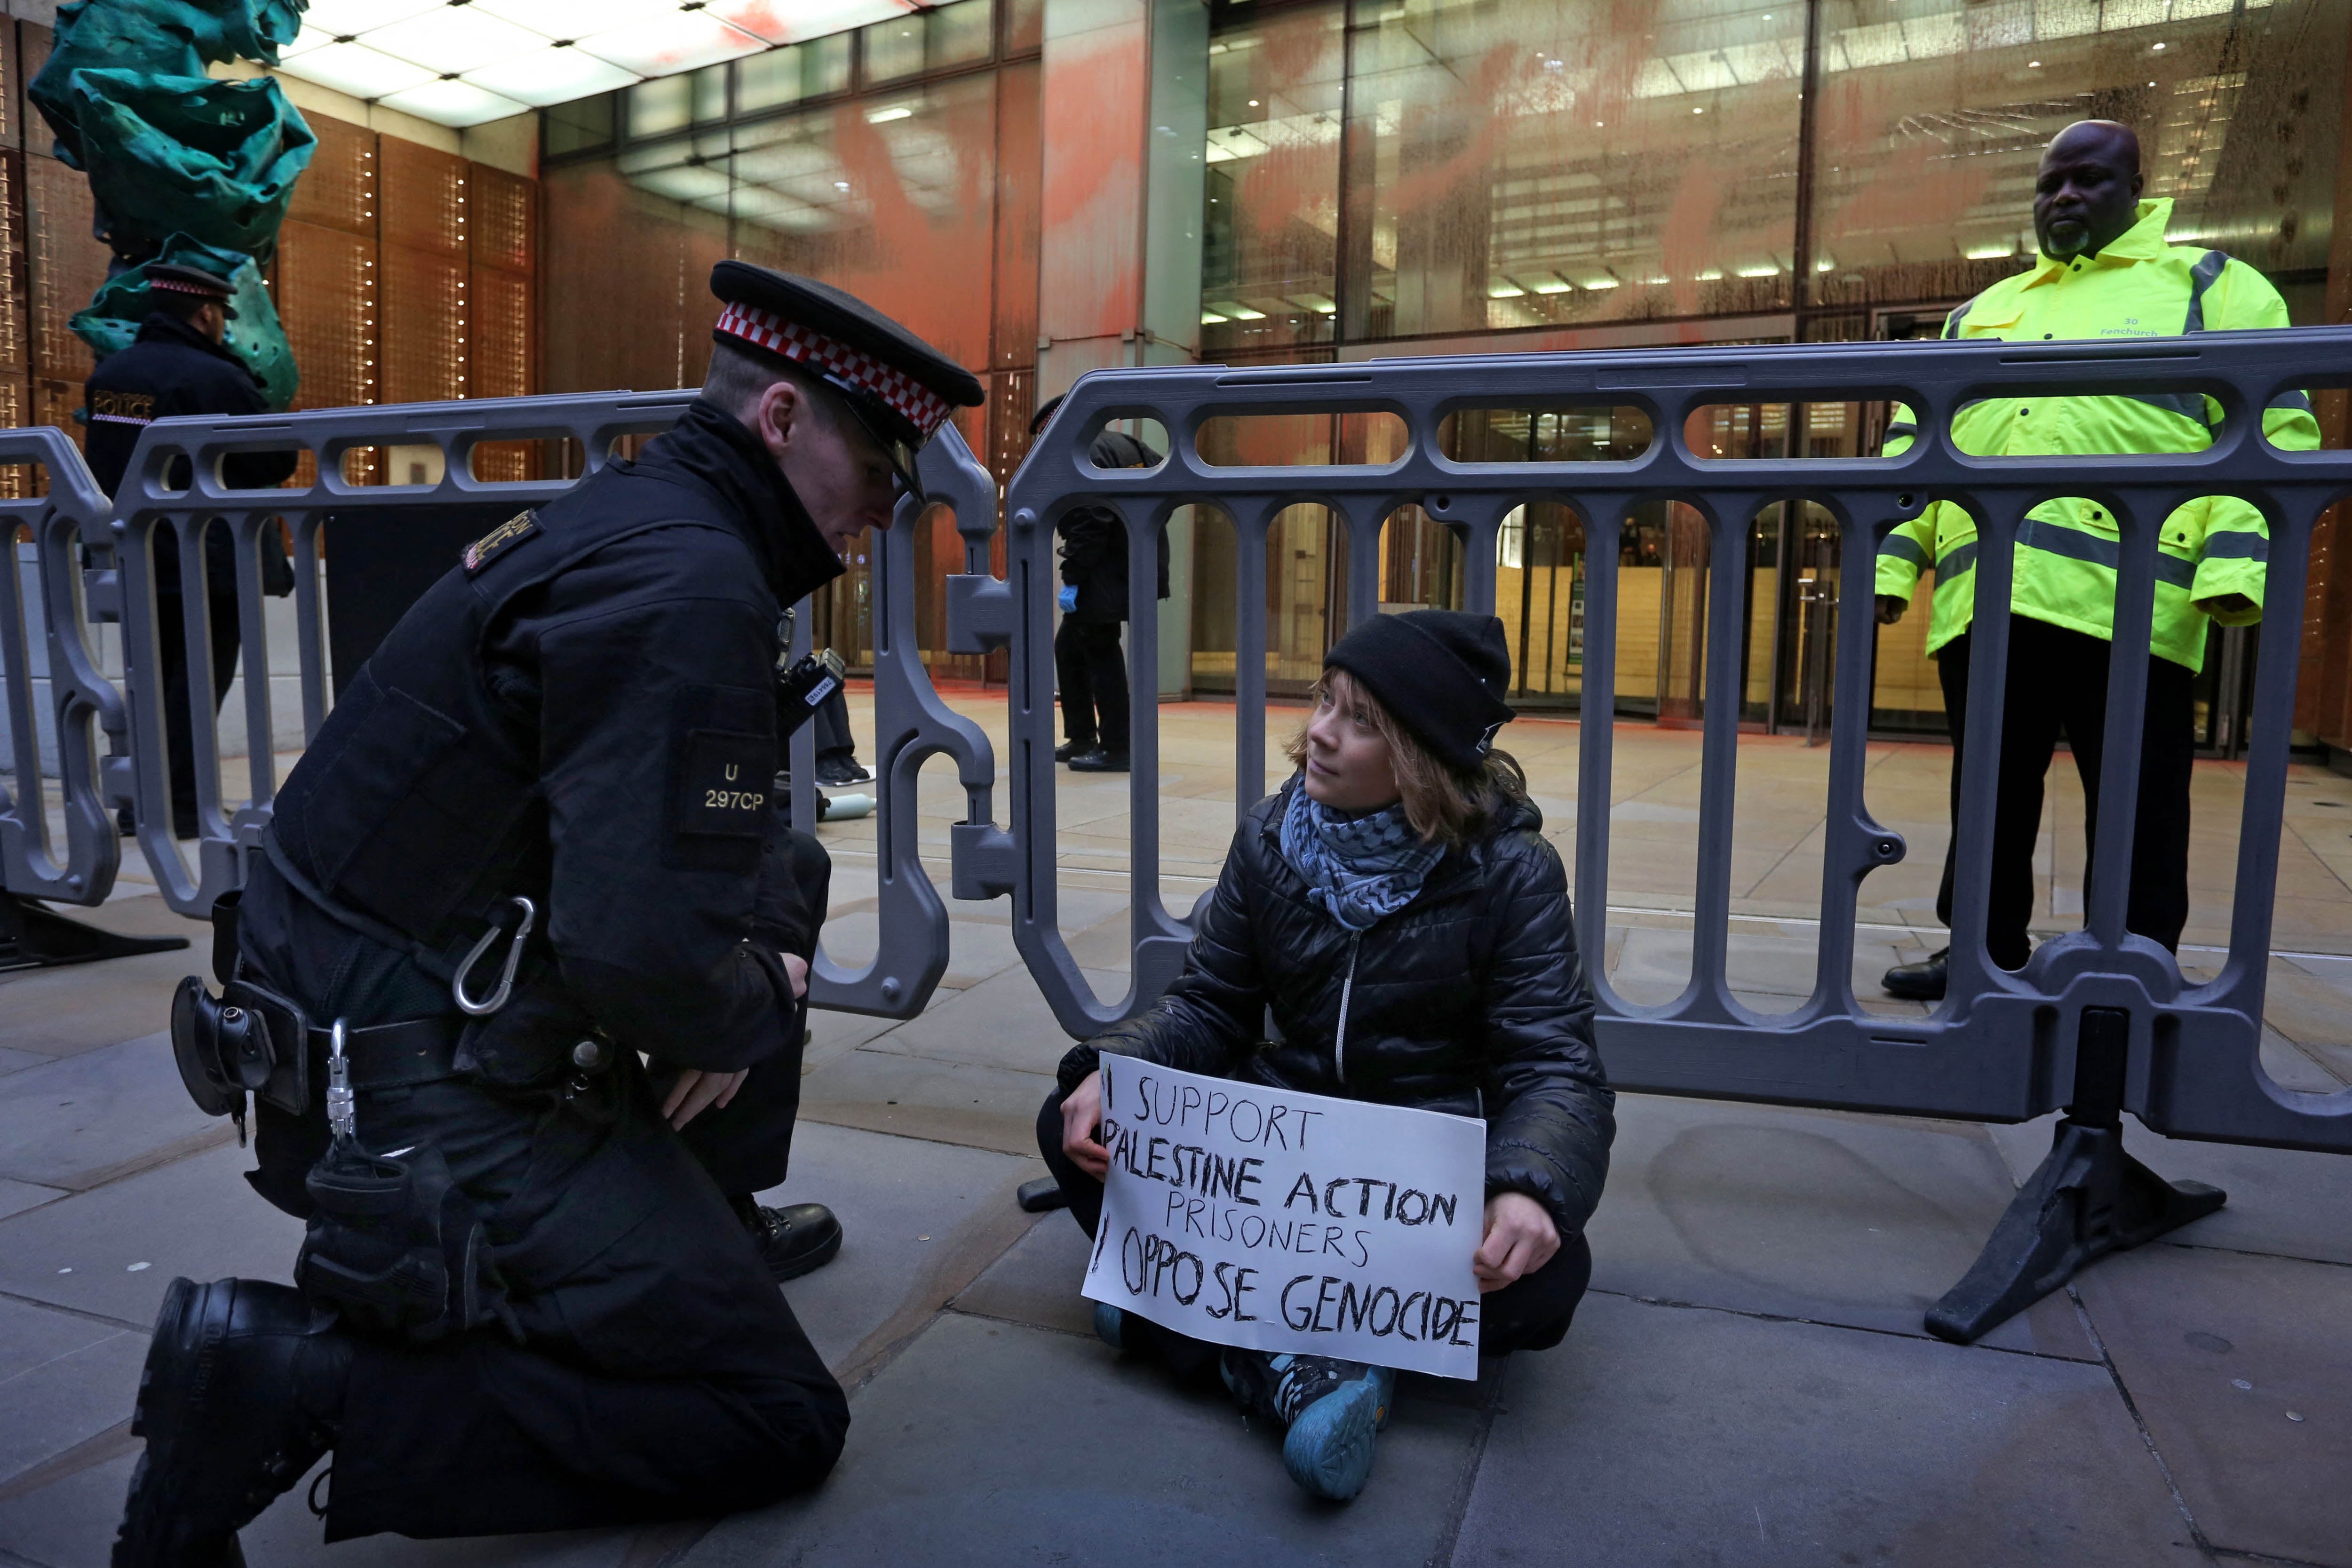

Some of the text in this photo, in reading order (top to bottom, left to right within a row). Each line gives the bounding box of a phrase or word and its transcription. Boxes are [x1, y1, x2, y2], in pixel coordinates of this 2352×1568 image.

[2100, 328, 2158, 337] Fenchurch
[94, 397, 152, 420] POLICE
[725, 763, 739, 781] U
[705, 789, 764, 811] 297CP
[1134, 1076, 1323, 1150] SUPPORT
[1103, 1119, 1457, 1226] PALESTINE ACTION
[1166, 1191, 1371, 1267] PRISONERS
[1122, 1226, 1259, 1321] OPPOSE
[1281, 1275, 1479, 1346] GENOCIDE
